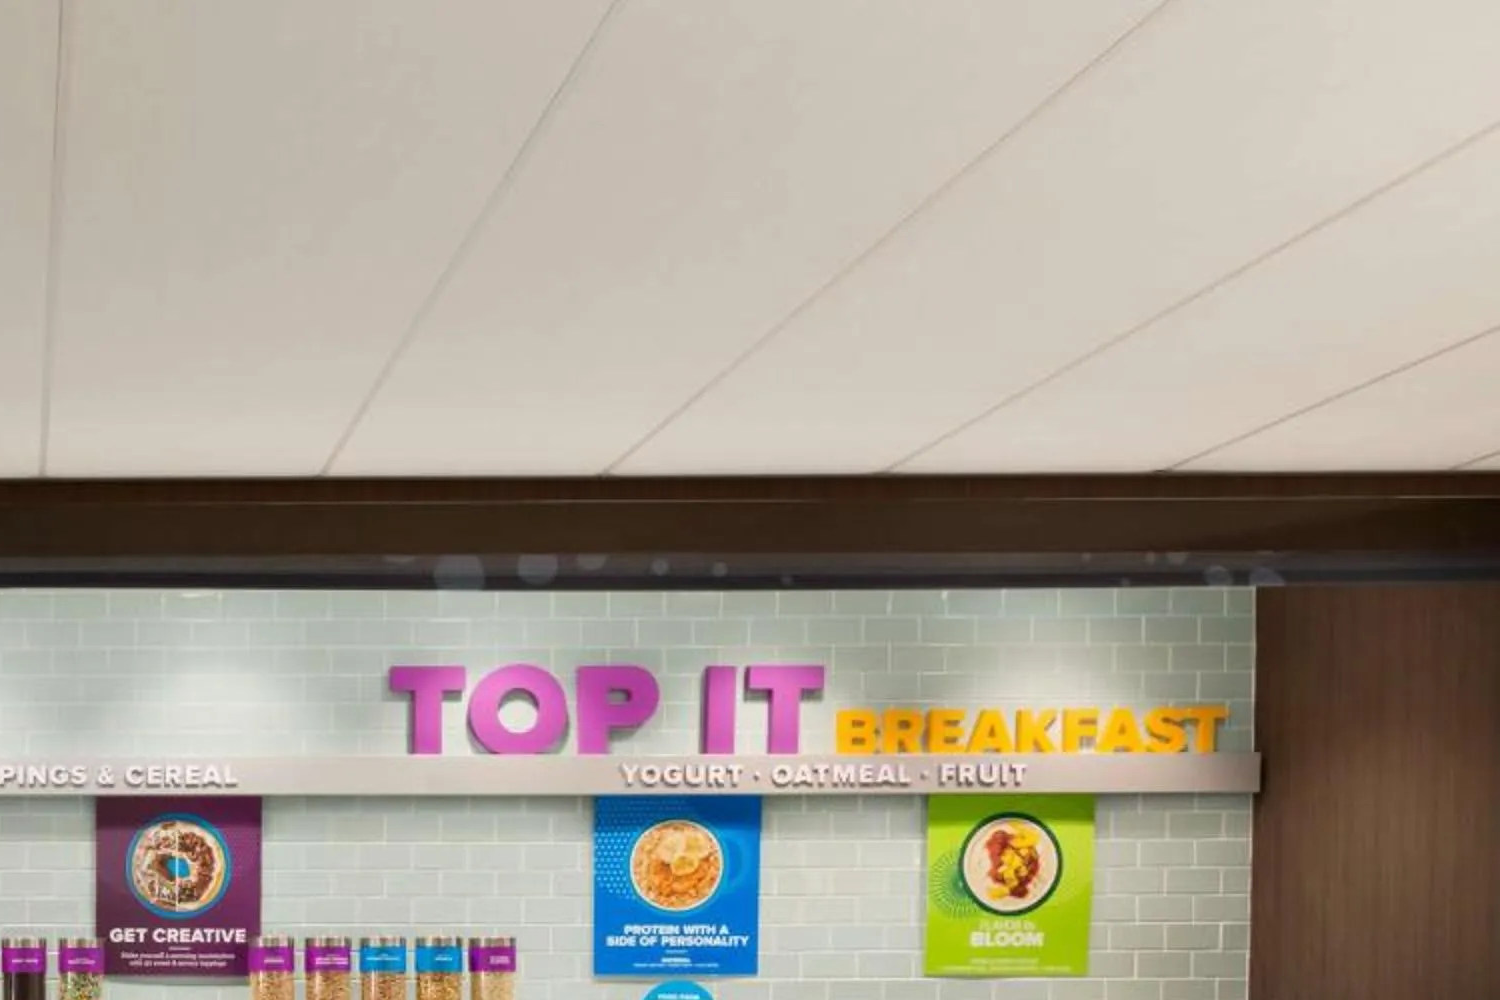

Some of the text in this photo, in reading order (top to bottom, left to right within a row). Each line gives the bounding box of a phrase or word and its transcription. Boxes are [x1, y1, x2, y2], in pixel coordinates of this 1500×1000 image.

[389, 664, 825, 754] TOP IT
[836, 704, 1229, 754] BREAKFAST
[96, 764, 116, 788] &
[124, 764, 238, 788] CEREAL
[622, 762, 1028, 787] YOGURT OATMEAL FRUIT
[109, 927, 247, 943] GET CREATIVE
[624, 924, 729, 935] PROTEIN WITH A
[969, 931, 1045, 947] BLOOM
[606, 935, 749, 947] SIDE OF PERSONALITY
